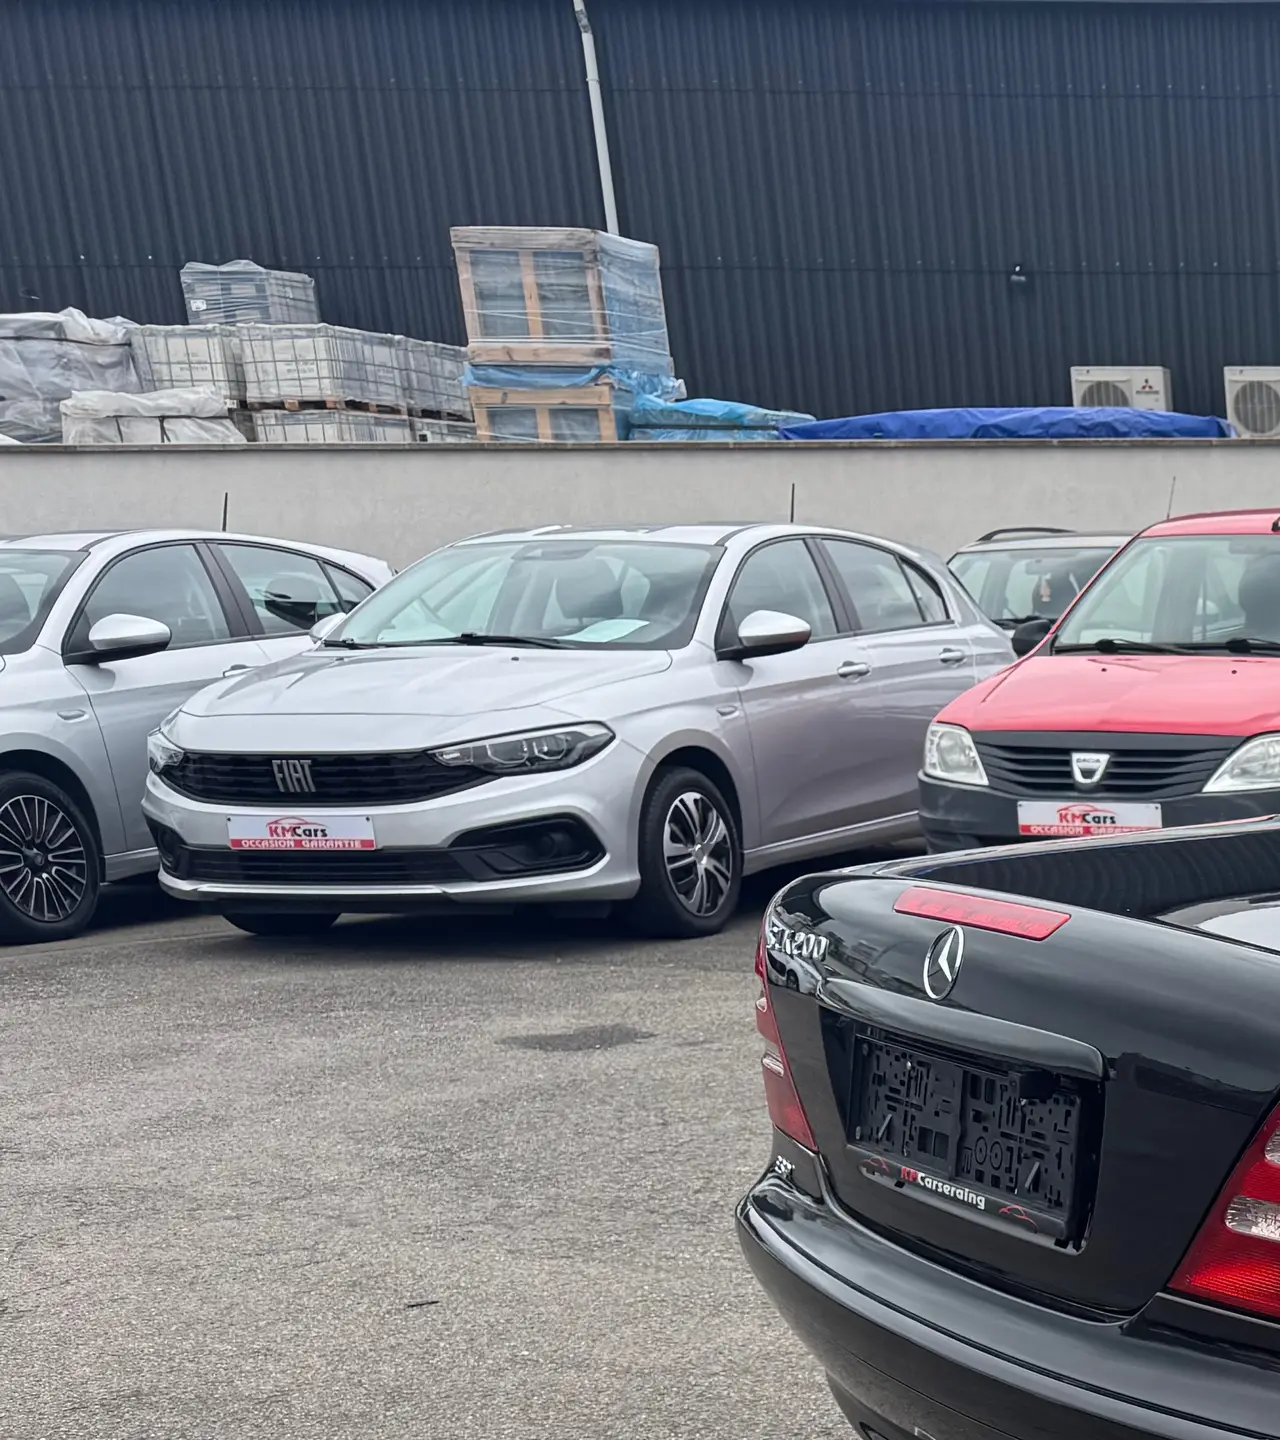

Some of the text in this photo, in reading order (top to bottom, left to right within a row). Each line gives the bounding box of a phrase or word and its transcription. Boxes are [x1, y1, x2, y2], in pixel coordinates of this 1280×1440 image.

[272, 759, 316, 792] FIAT
[1059, 812, 1117, 825] KMCars
[268, 826, 328, 838] KMCars
[1030, 825, 1085, 836] OCCASION
[241, 839, 362, 849] OCCASION GARANTIE
